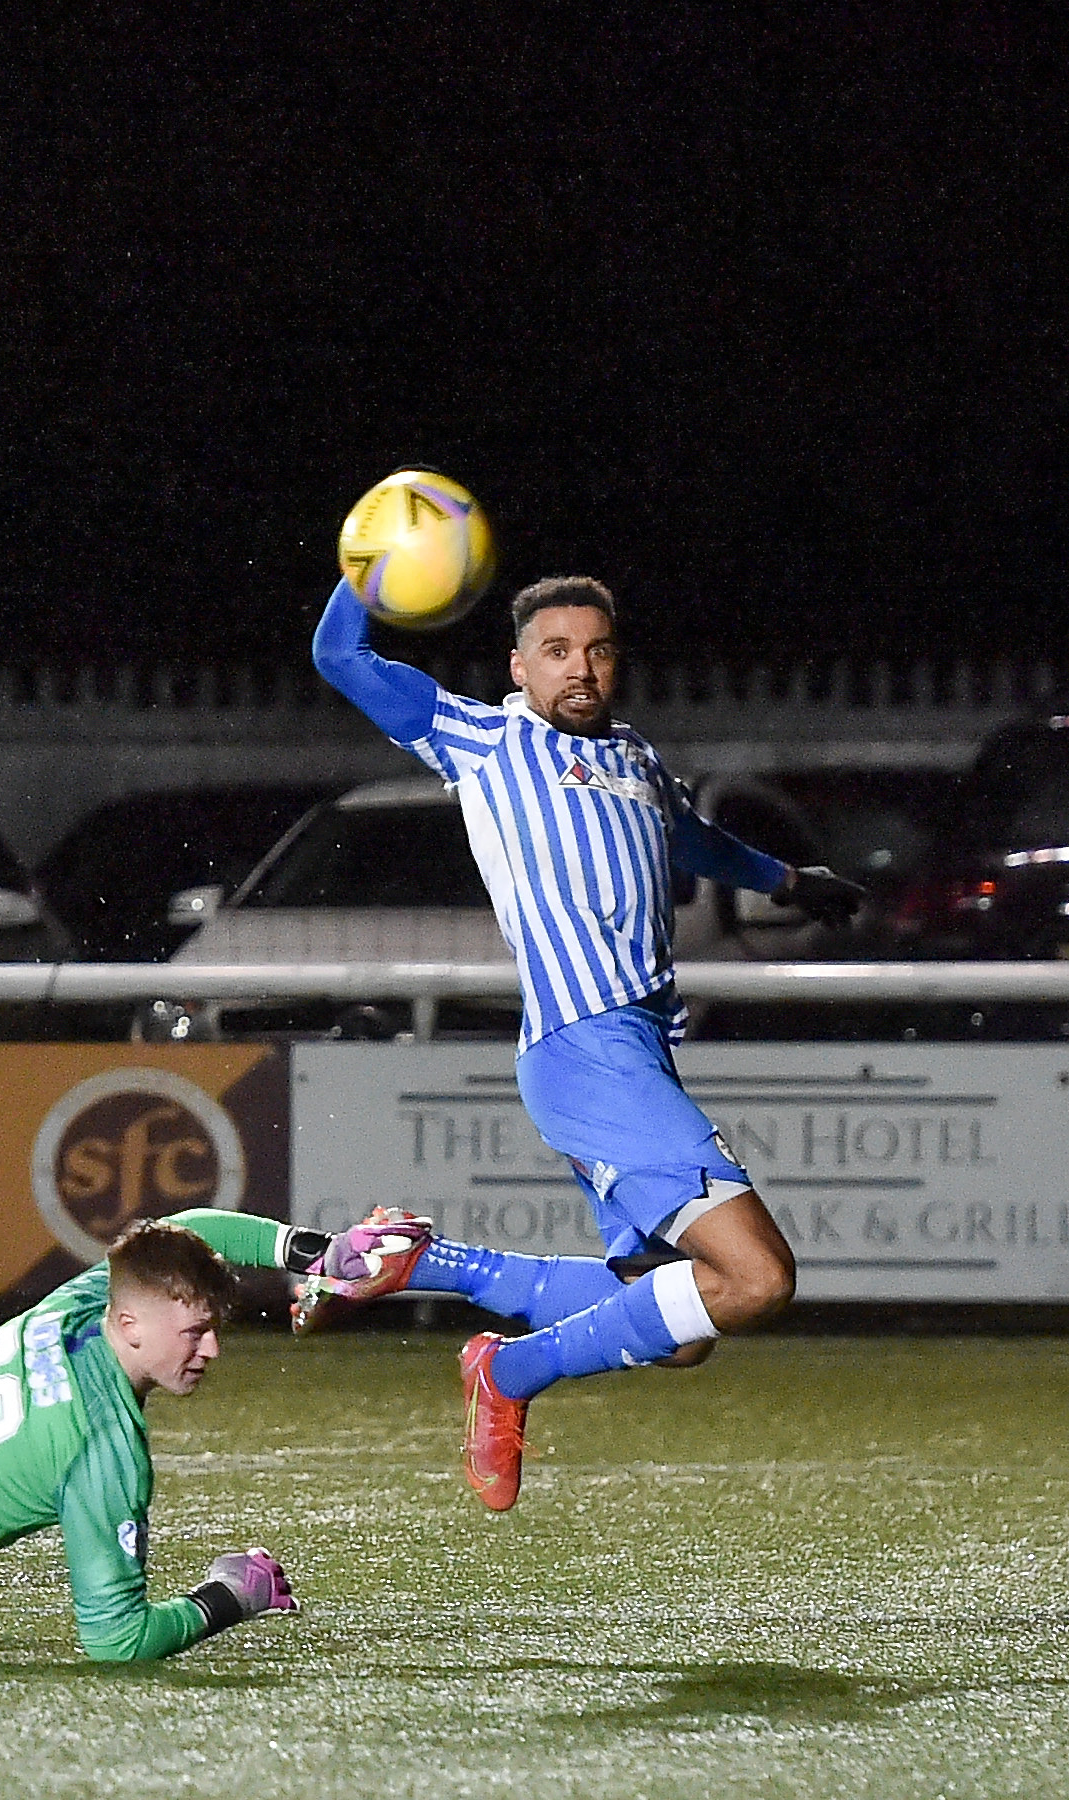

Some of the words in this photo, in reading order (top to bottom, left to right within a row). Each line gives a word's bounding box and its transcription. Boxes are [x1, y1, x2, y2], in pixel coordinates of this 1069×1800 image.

[400, 1109, 508, 1164] THE
[801, 1110, 998, 1168] HOTEL
[59, 1106, 216, 1238] sfc
